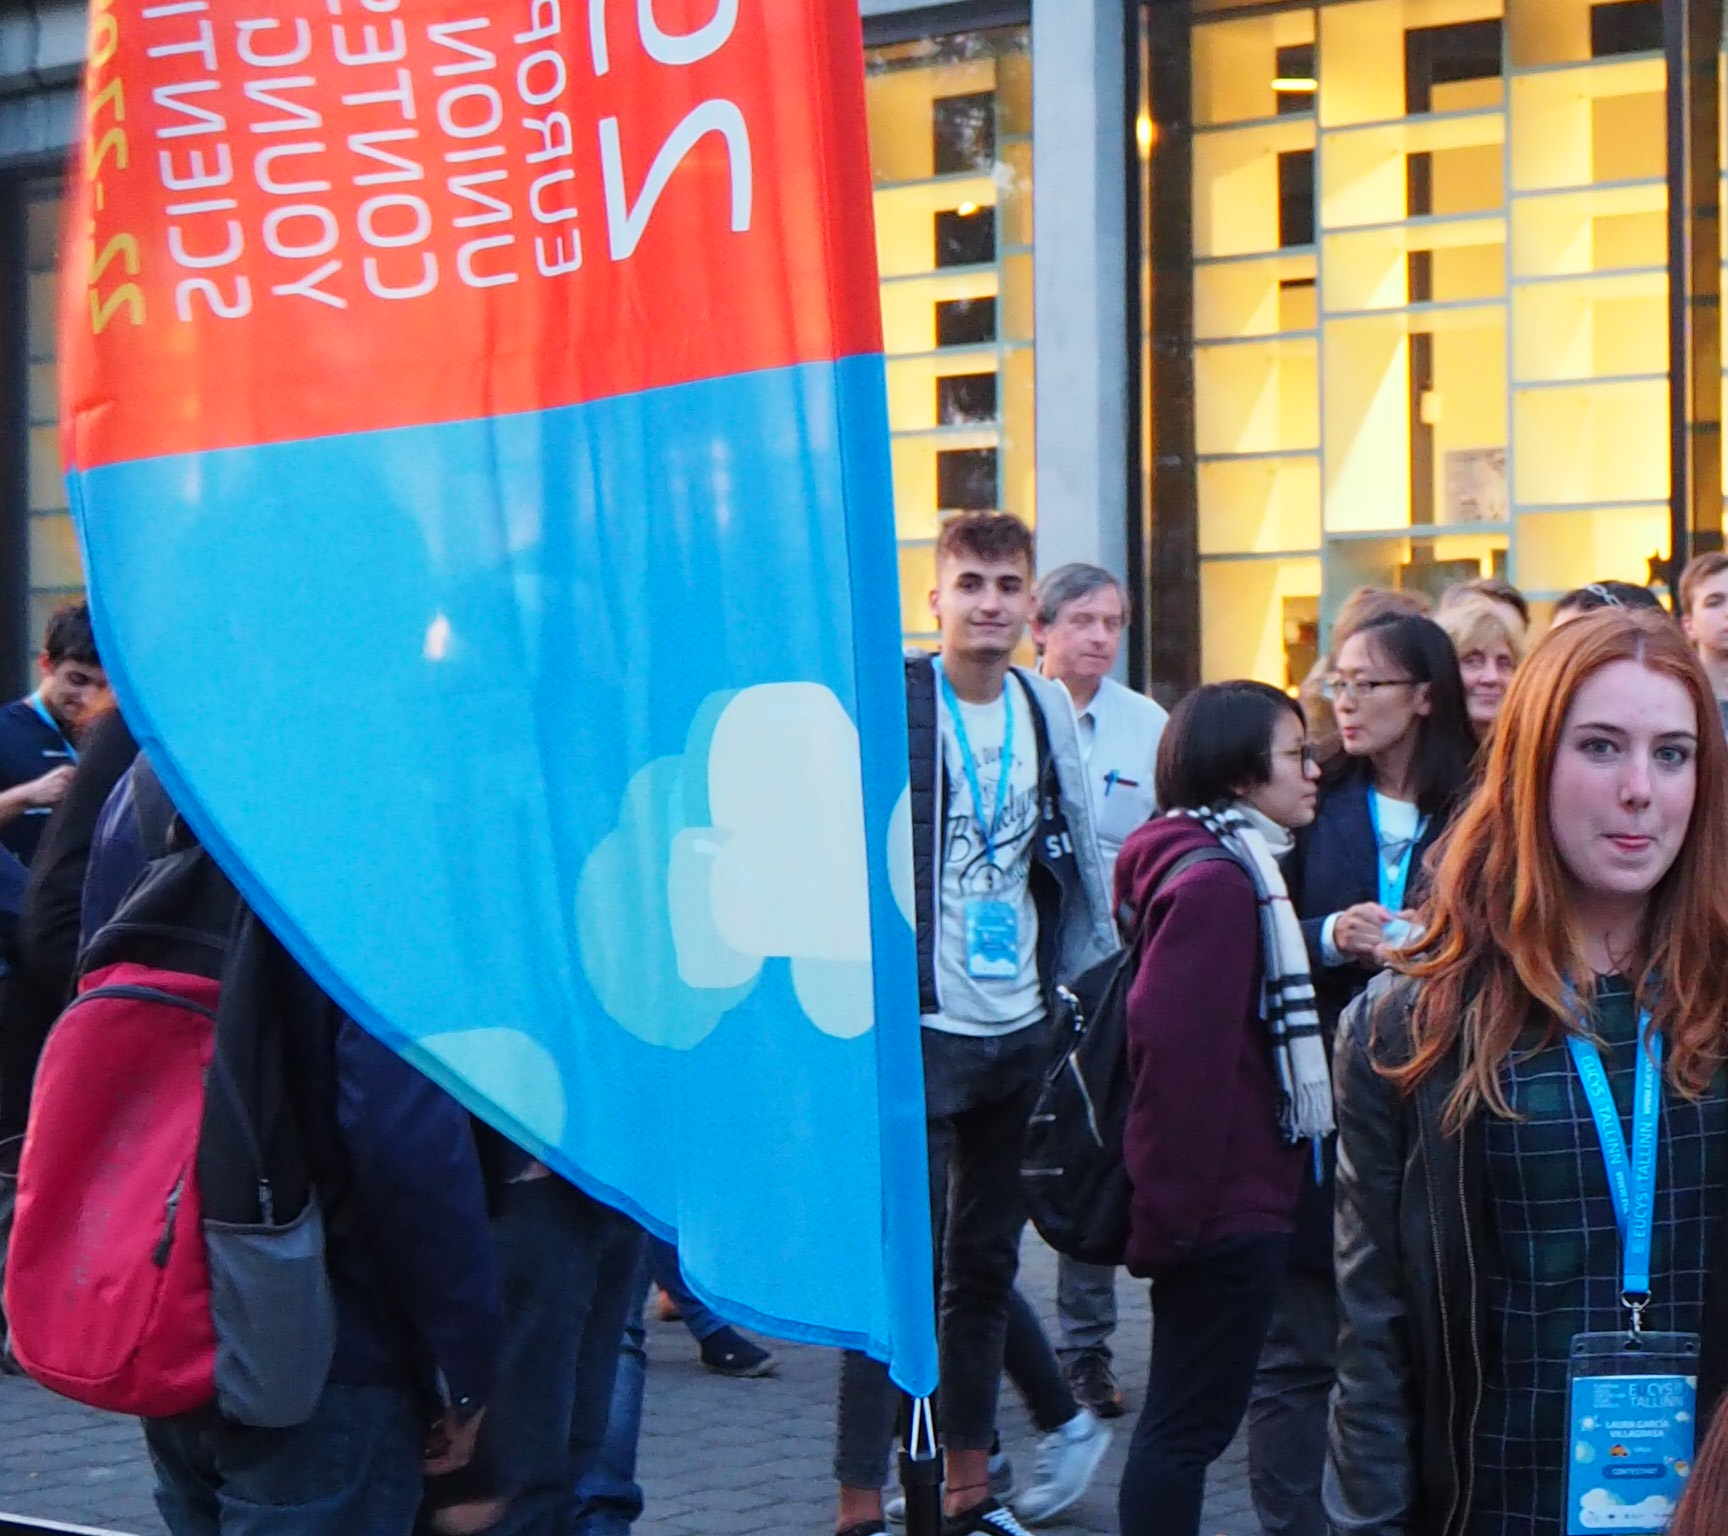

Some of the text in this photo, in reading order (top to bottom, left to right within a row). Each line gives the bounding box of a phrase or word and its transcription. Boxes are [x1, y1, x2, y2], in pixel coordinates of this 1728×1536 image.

[1598, 1104, 1622, 1166] TALLINN
[1636, 1120, 1654, 1185] TALLINN
[1635, 1193, 1649, 1238] EUCYS
